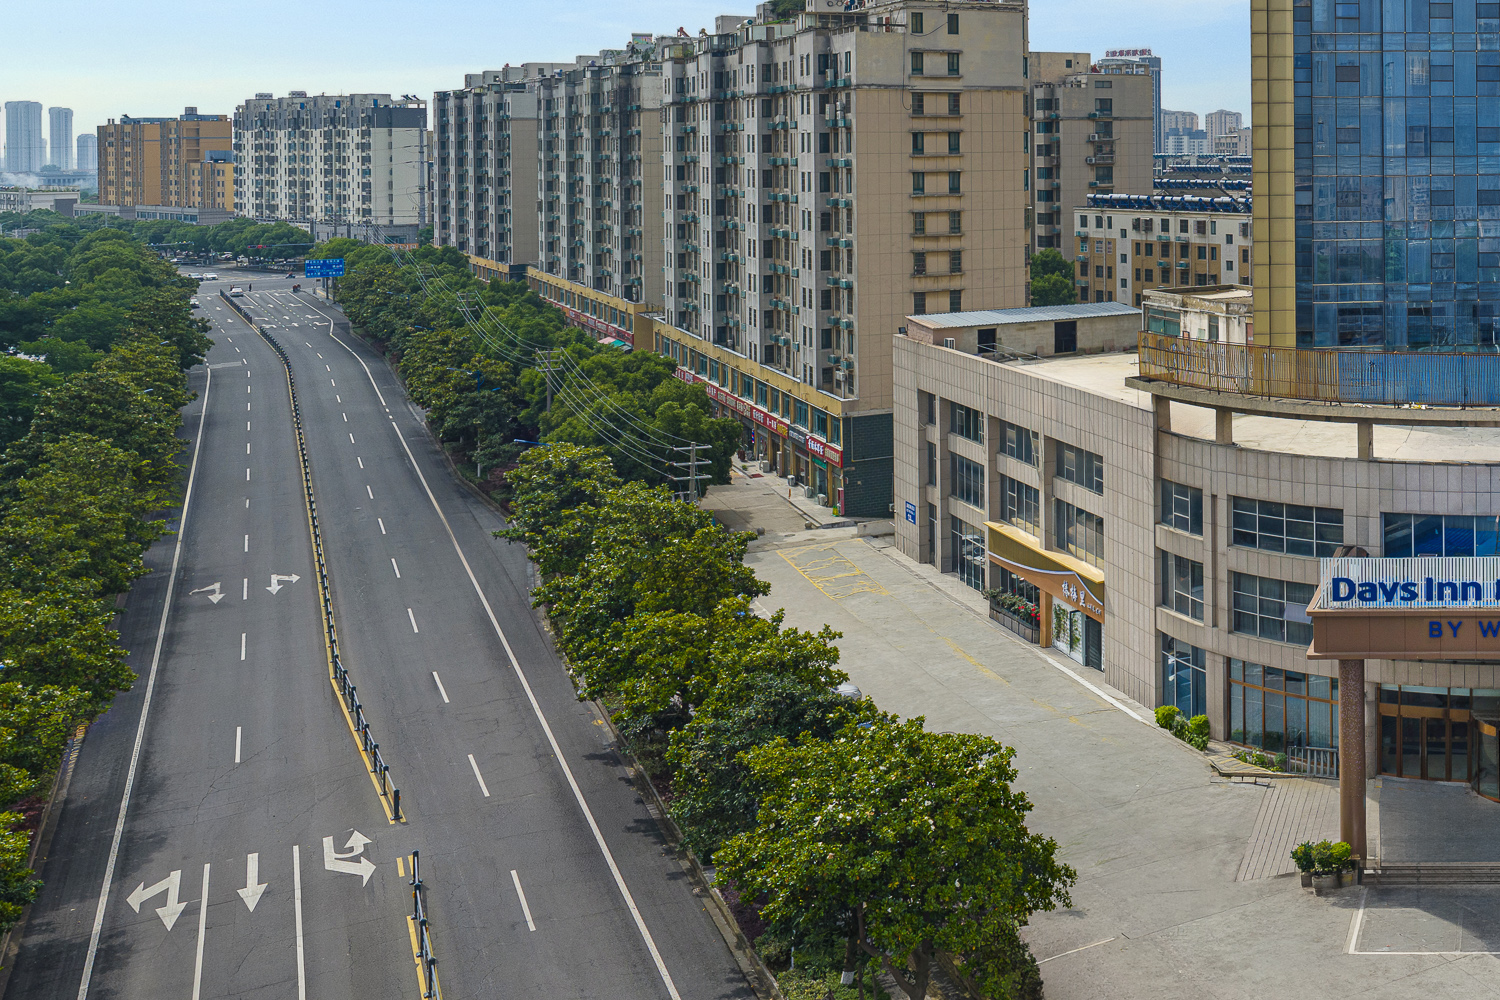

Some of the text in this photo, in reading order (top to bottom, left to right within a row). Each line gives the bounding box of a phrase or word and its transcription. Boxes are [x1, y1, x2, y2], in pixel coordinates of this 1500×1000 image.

[1332, 577, 1418, 602] Days
[1426, 577, 1482, 601] Inn
[1428, 621, 1463, 638] BY
